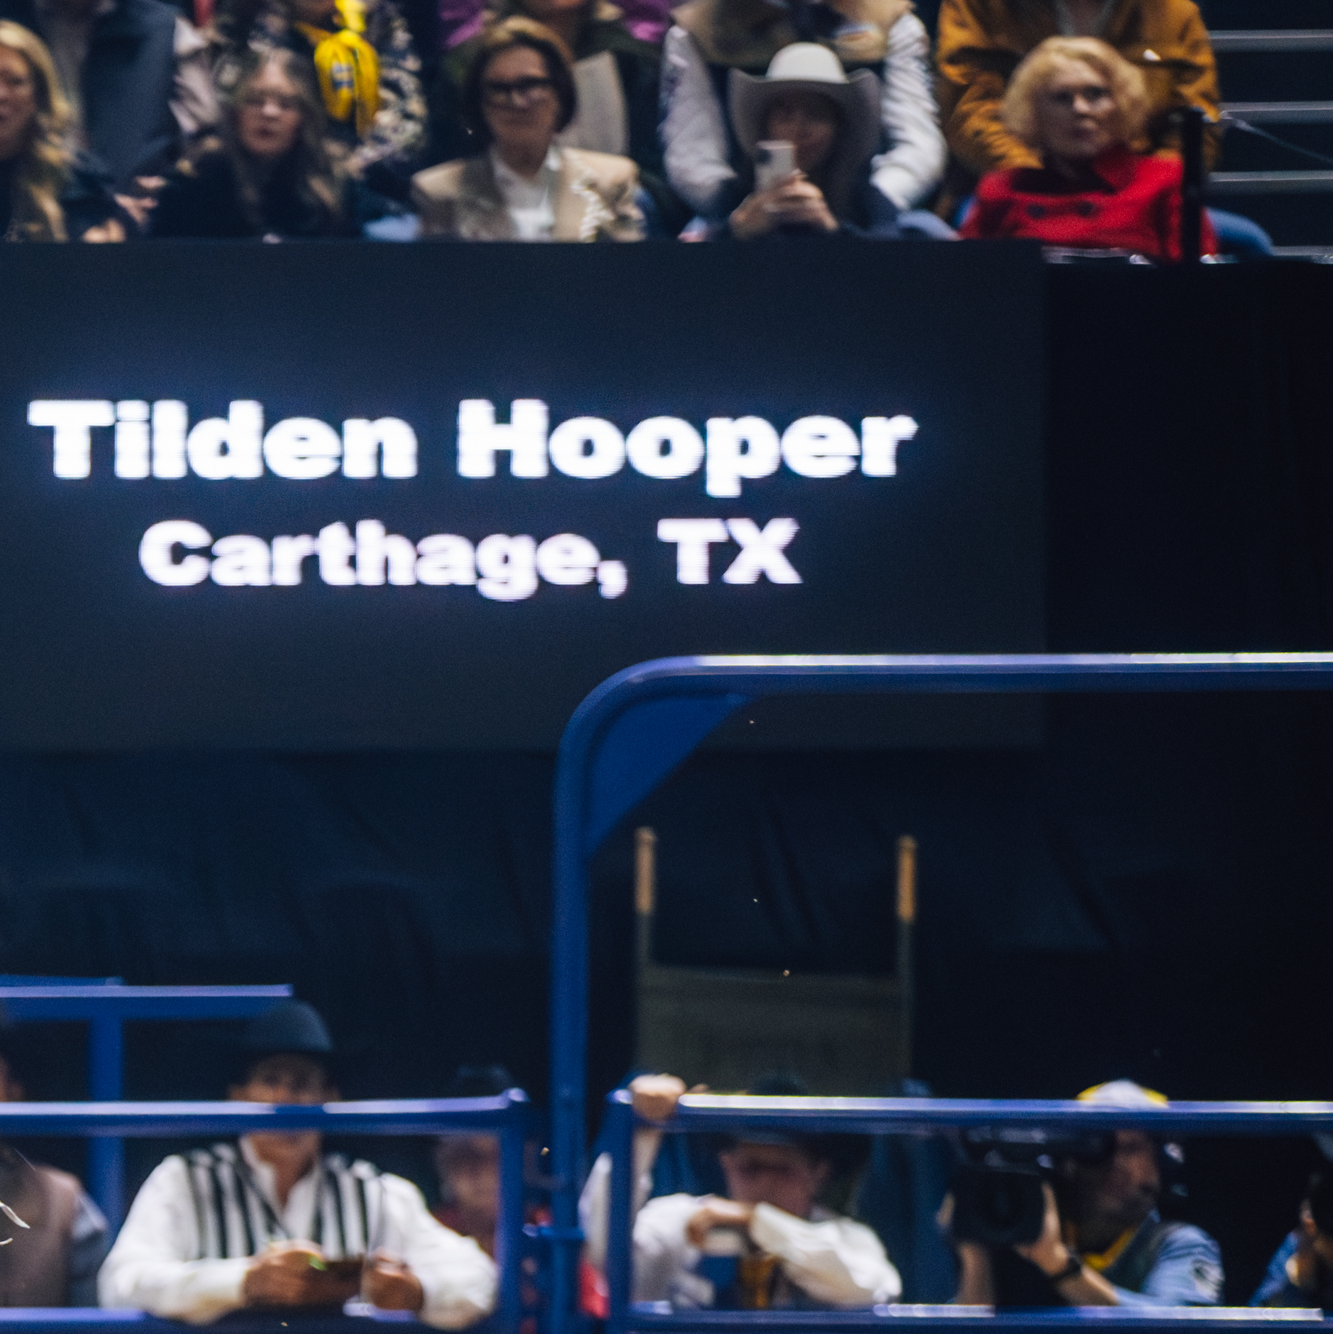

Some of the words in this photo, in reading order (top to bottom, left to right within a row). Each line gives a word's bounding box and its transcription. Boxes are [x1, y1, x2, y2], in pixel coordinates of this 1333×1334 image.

[27, 399, 418, 480] Tilden
[457, 398, 919, 498] Hooper
[138, 519, 629, 601] Carthage,
[656, 517, 803, 585] TX
